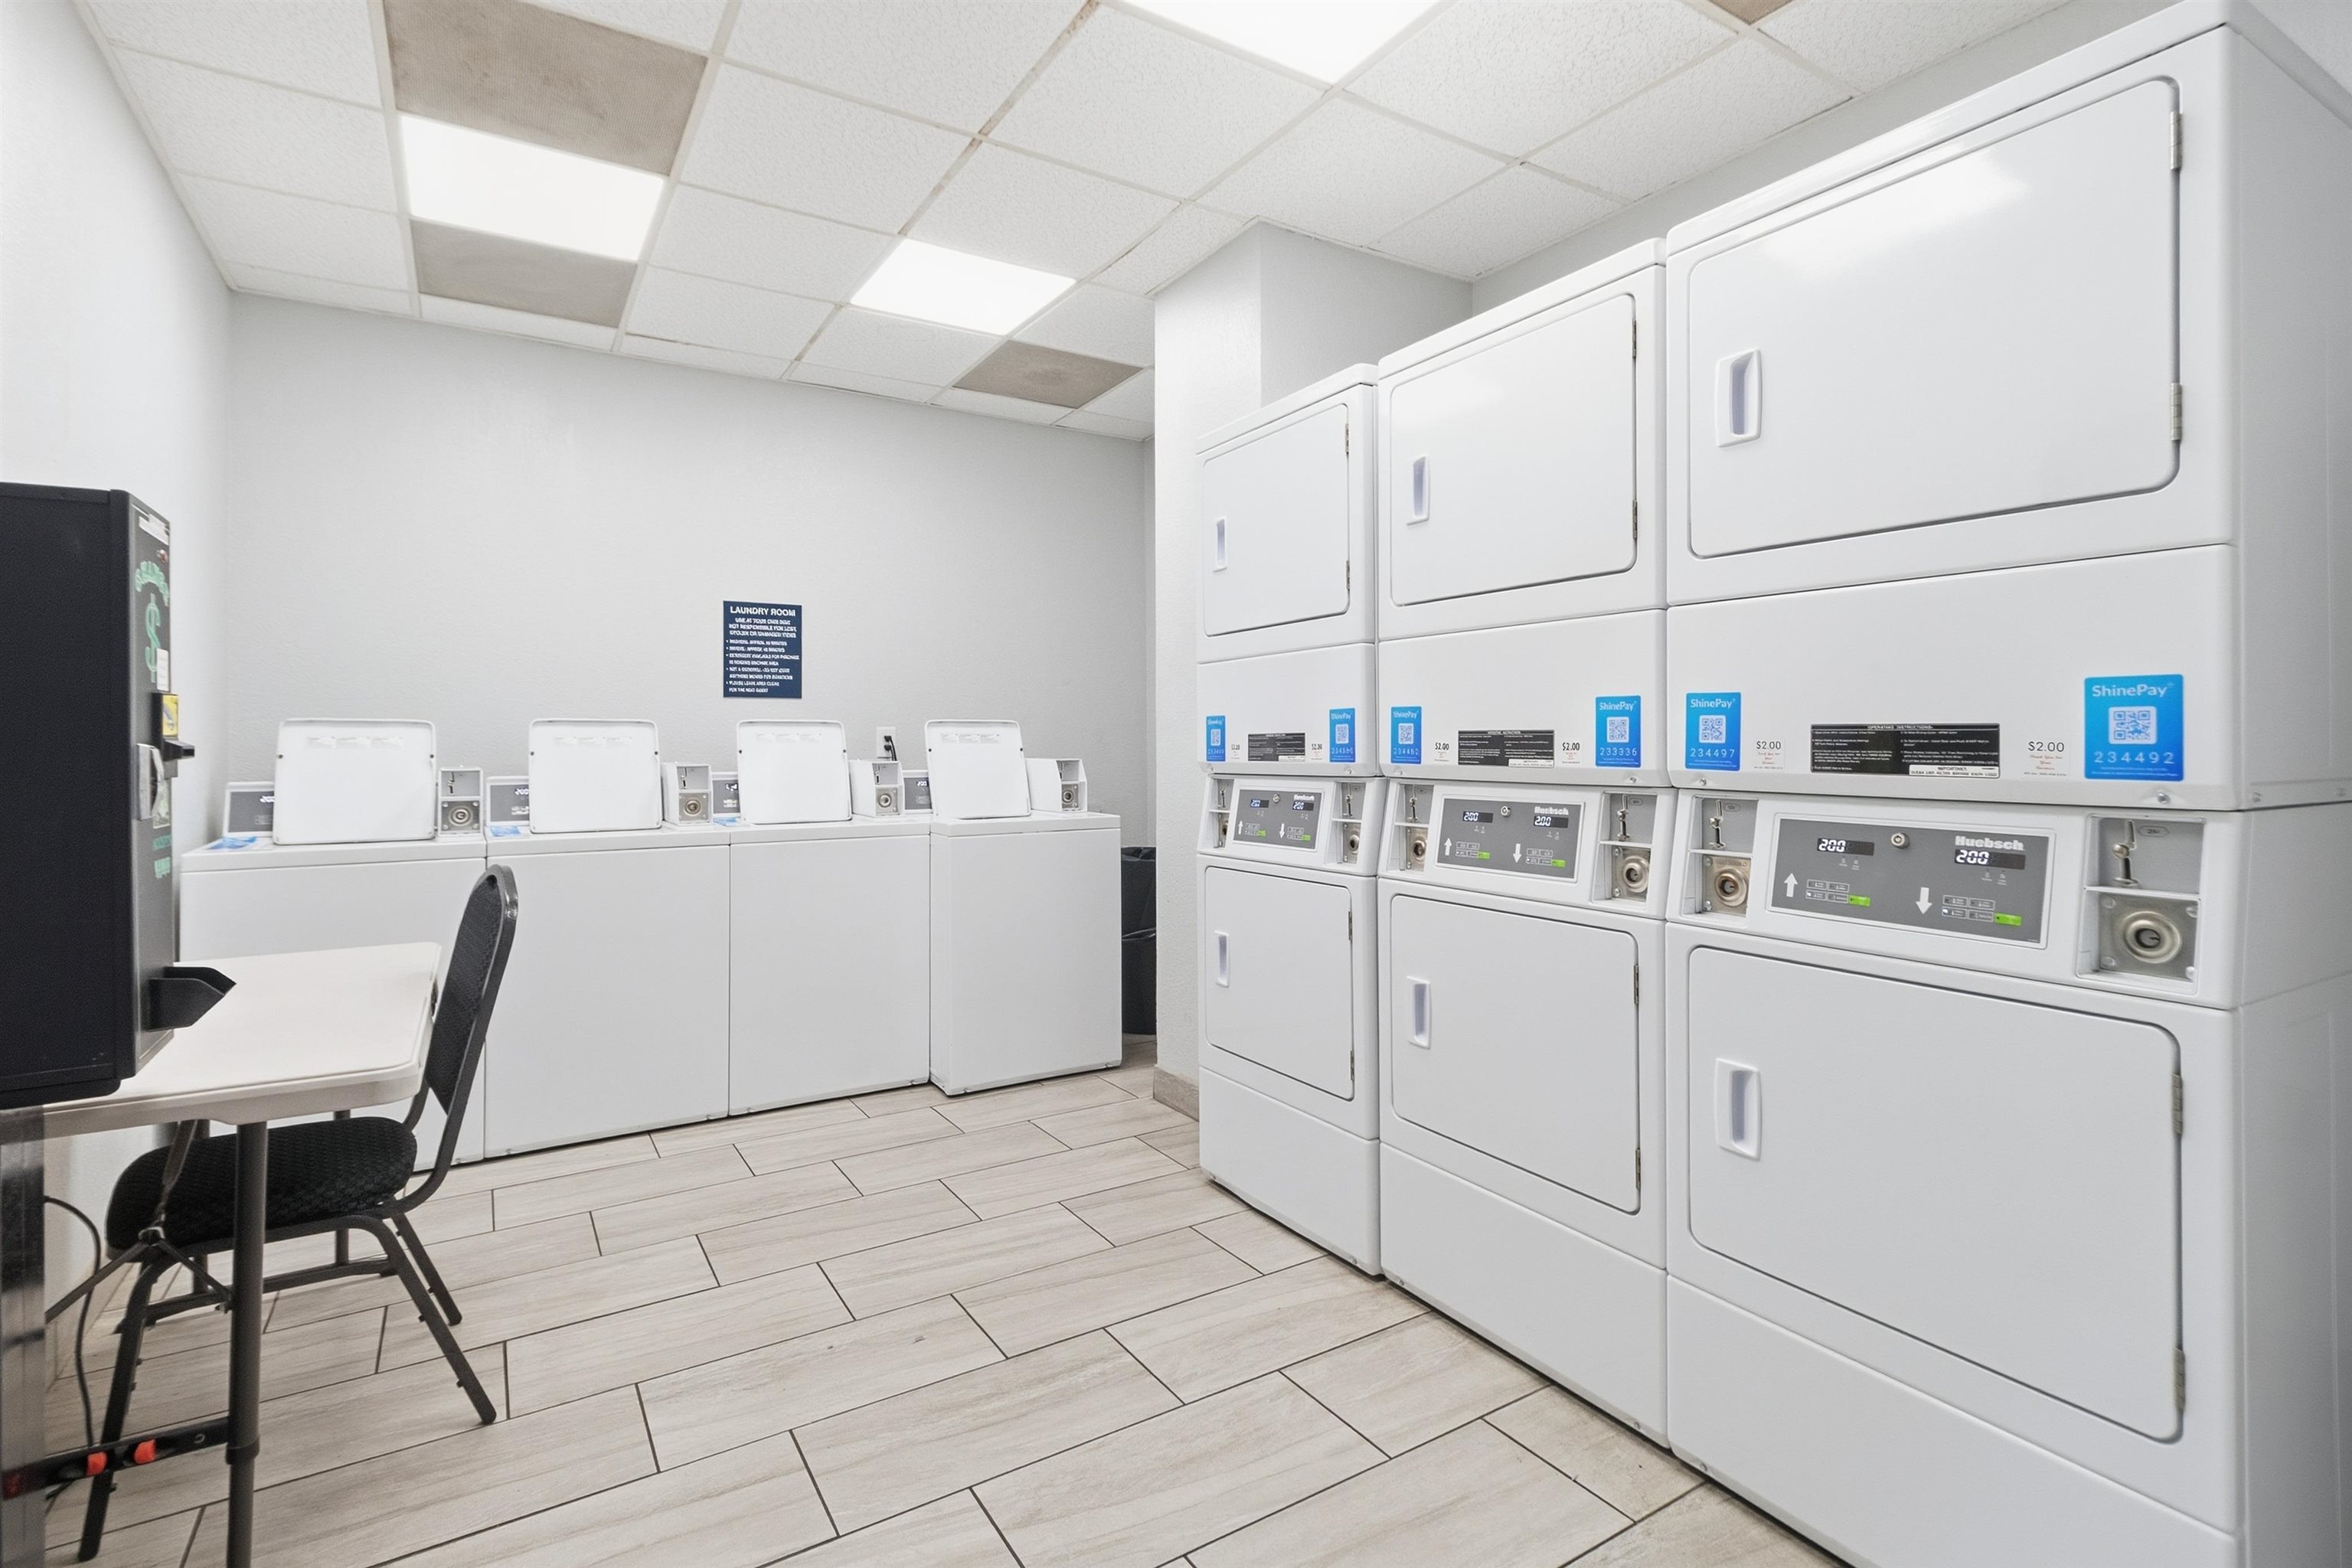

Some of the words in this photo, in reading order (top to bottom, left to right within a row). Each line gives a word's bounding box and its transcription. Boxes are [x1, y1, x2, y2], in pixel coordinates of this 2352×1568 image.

[730, 606, 769, 615] LAUNDRY
[770, 608, 795, 616] ROOM
[2092, 684, 2167, 697] ShinePay
[1690, 698, 1732, 709] ShinePay
[1562, 742, 1580, 750] $2.00
[1756, 740, 1782, 750] $2.00
[2028, 741, 2064, 752] $2.00
[1600, 747, 1637, 756] 233336
[1690, 748, 1734, 757] 234497
[2094, 751, 2174, 764] 234492
[1818, 839, 1846, 852] 200
[1955, 835, 2024, 851] Huebsch
[1956, 850, 1989, 864] 200
